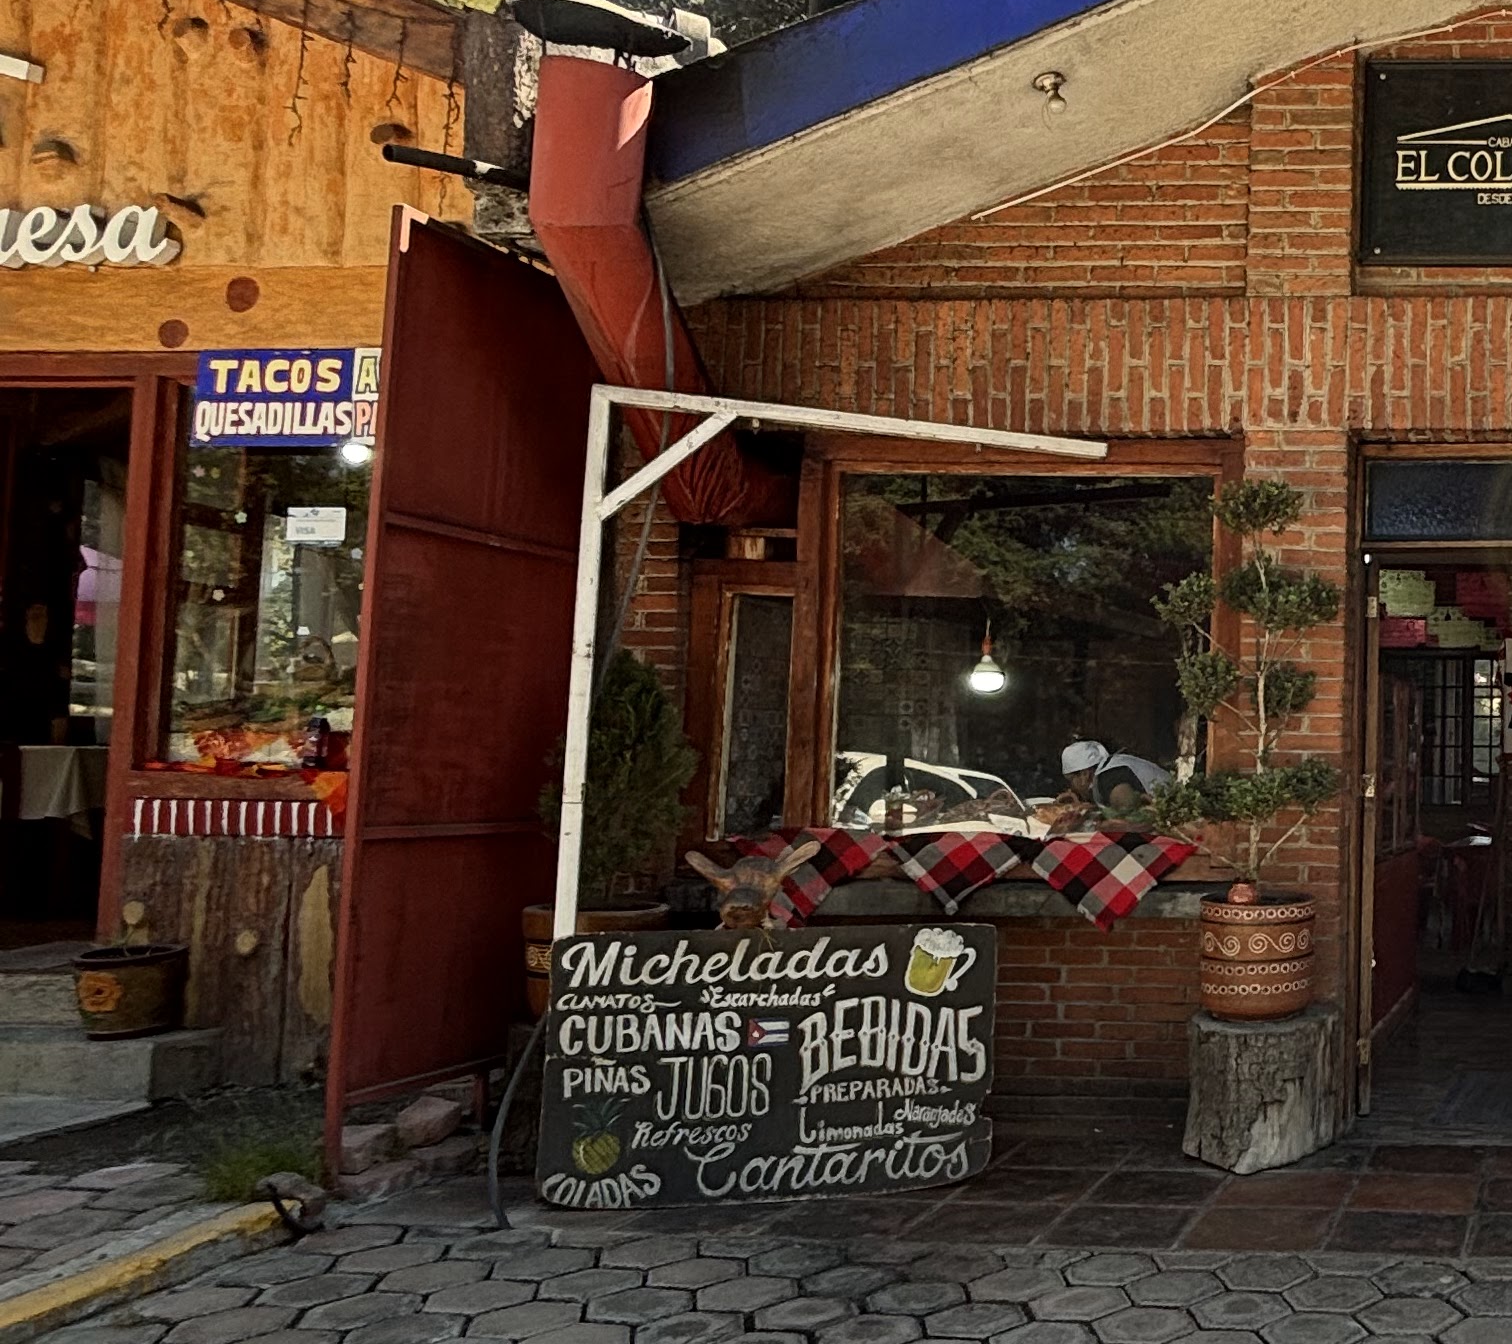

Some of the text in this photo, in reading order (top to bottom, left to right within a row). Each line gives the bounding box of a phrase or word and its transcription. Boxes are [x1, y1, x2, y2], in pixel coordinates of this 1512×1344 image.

[1395, 150, 1440, 182] EL
[209, 358, 343, 393] TACOS
[195, 401, 353, 442] QUESADILLAS
[561, 936, 889, 987] Micheladas
[557, 993, 681, 1013] CLAMATOS
[559, 1011, 742, 1056] CUBANAS
[797, 996, 986, 1095] BEBIDAS
[562, 1057, 651, 1099] PIÑAS
[656, 1053, 772, 1121] JUGOS
[810, 1076, 942, 1104] PREPARADAS
[631, 1121, 753, 1150] Refrescos
[799, 1101, 905, 1144] Limonadas
[683, 1130, 970, 1198] Cantaritos
